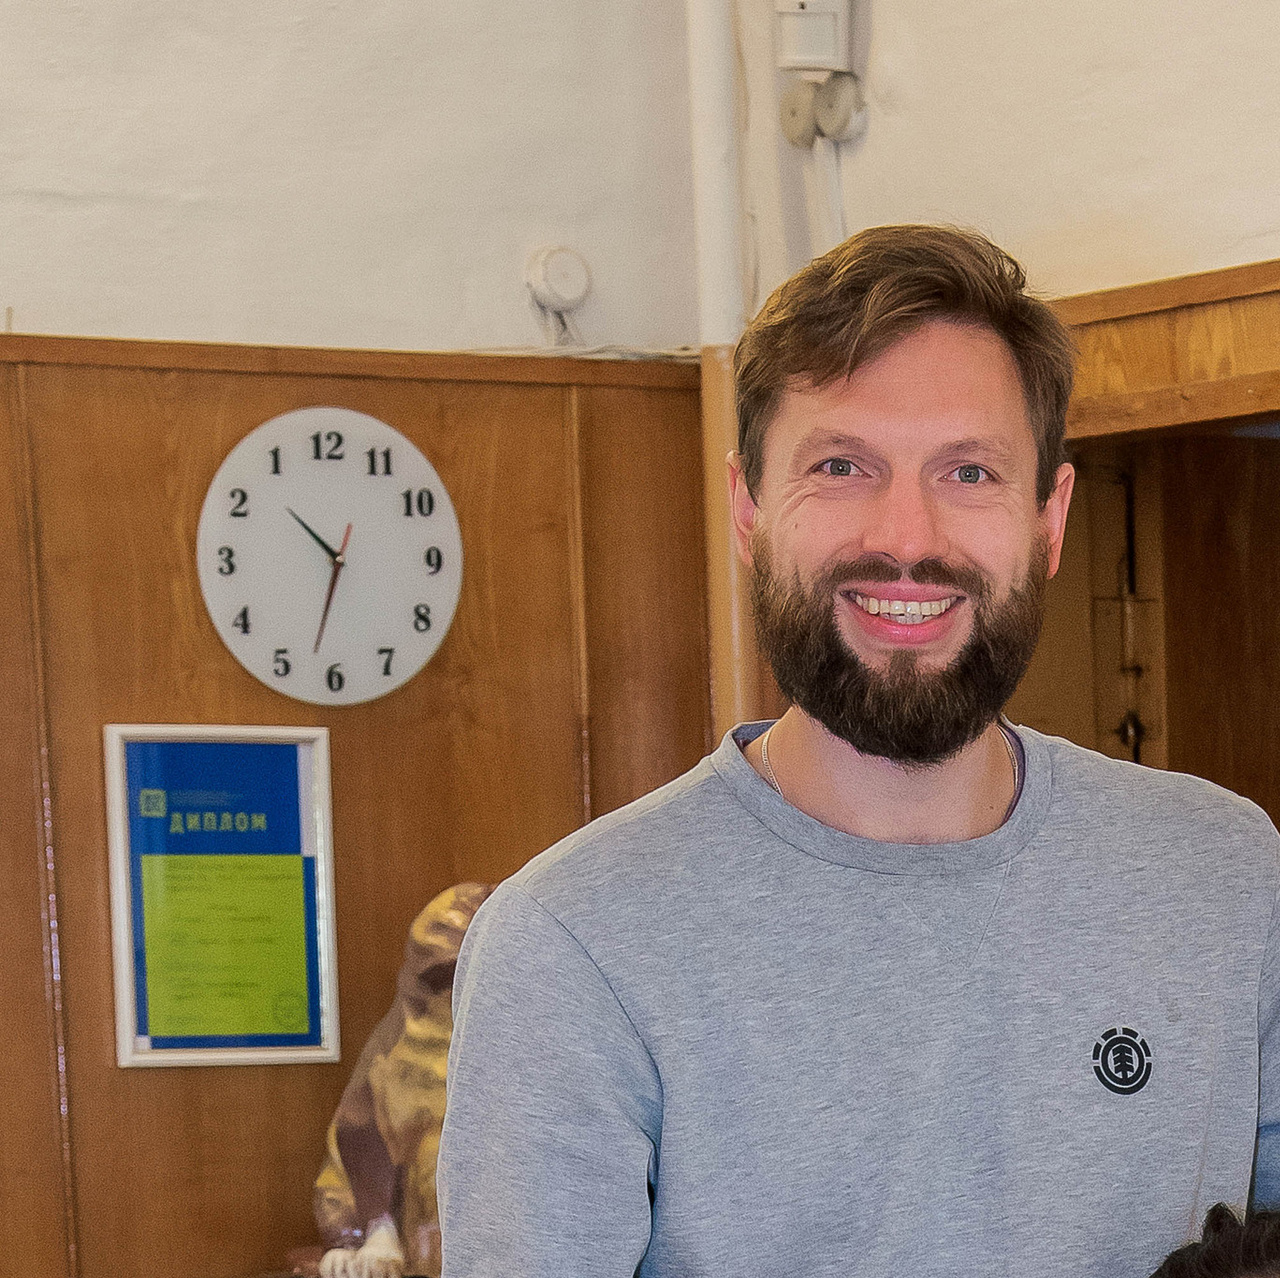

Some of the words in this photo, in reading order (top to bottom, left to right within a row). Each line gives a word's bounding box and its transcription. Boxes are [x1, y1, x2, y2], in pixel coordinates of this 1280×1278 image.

[311, 431, 344, 460] 12
[269, 447, 282, 475] 1
[366, 448, 393, 475] 11
[230, 488, 248, 517] 2
[401, 488, 434, 516] 10
[218, 547, 236, 575] 3
[425, 546, 443, 575] 9
[232, 605, 250, 634] 4
[413, 603, 431, 632] 8
[273, 648, 291, 676] 5
[378, 648, 395, 676] 7
[326, 663, 344, 691] 6
[169, 812, 267, 834] ДИПЛОМ
